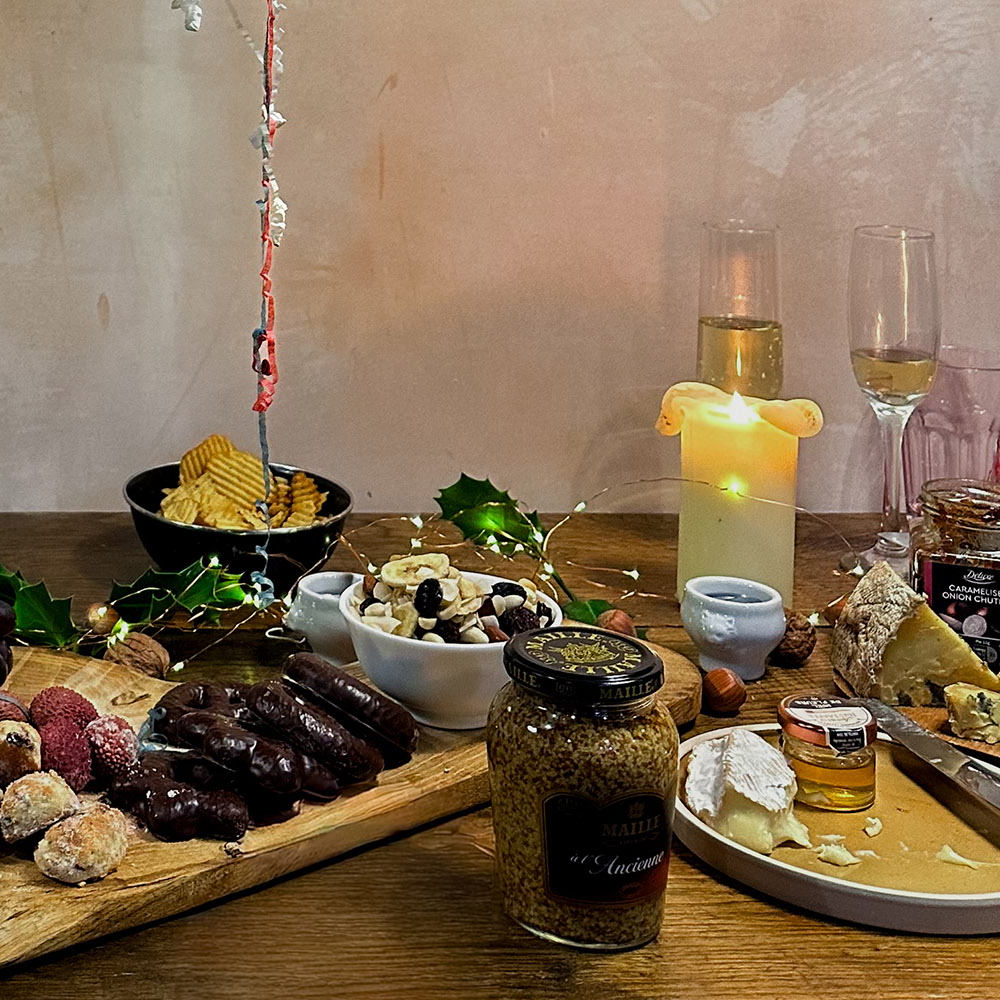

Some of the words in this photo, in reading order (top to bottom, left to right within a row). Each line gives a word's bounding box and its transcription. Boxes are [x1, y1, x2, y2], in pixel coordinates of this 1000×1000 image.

[963, 569, 995, 581] Deluxe
[942, 591, 972, 602] ONION
[973, 595, 1000, 606] CHUT
[525, 631, 604, 651] MAILLE
[561, 652, 643, 674] MAILLE
[508, 662, 538, 688] AILLE
[601, 679, 655, 700] MAILLE
